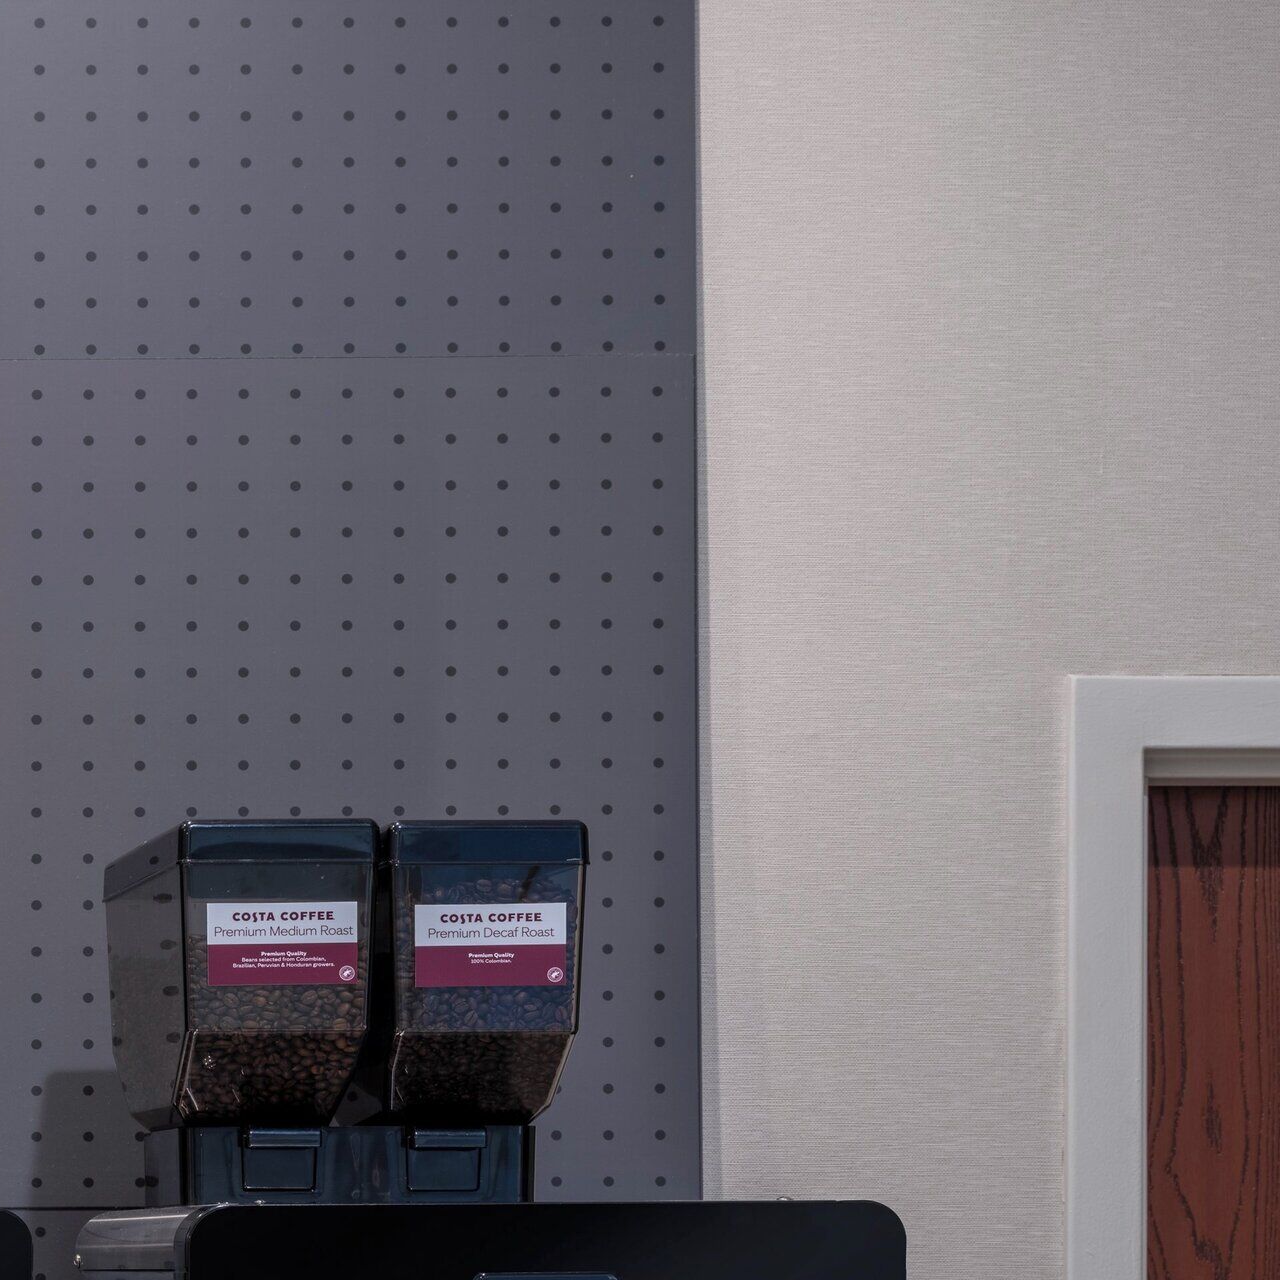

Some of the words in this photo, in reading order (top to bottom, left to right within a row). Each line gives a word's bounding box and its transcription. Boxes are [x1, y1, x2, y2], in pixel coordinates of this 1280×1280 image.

[232, 912, 275, 922] COSTA
[280, 911, 334, 921] COFFEE
[440, 914, 483, 924] COSTA
[488, 912, 542, 922] COFFEE
[214, 926, 266, 937] Premium
[269, 925, 317, 936] Medium
[320, 925, 354, 936] Roast
[428, 928, 480, 939] Premium
[484, 927, 518, 938] Decaf
[521, 927, 554, 937] Roast
